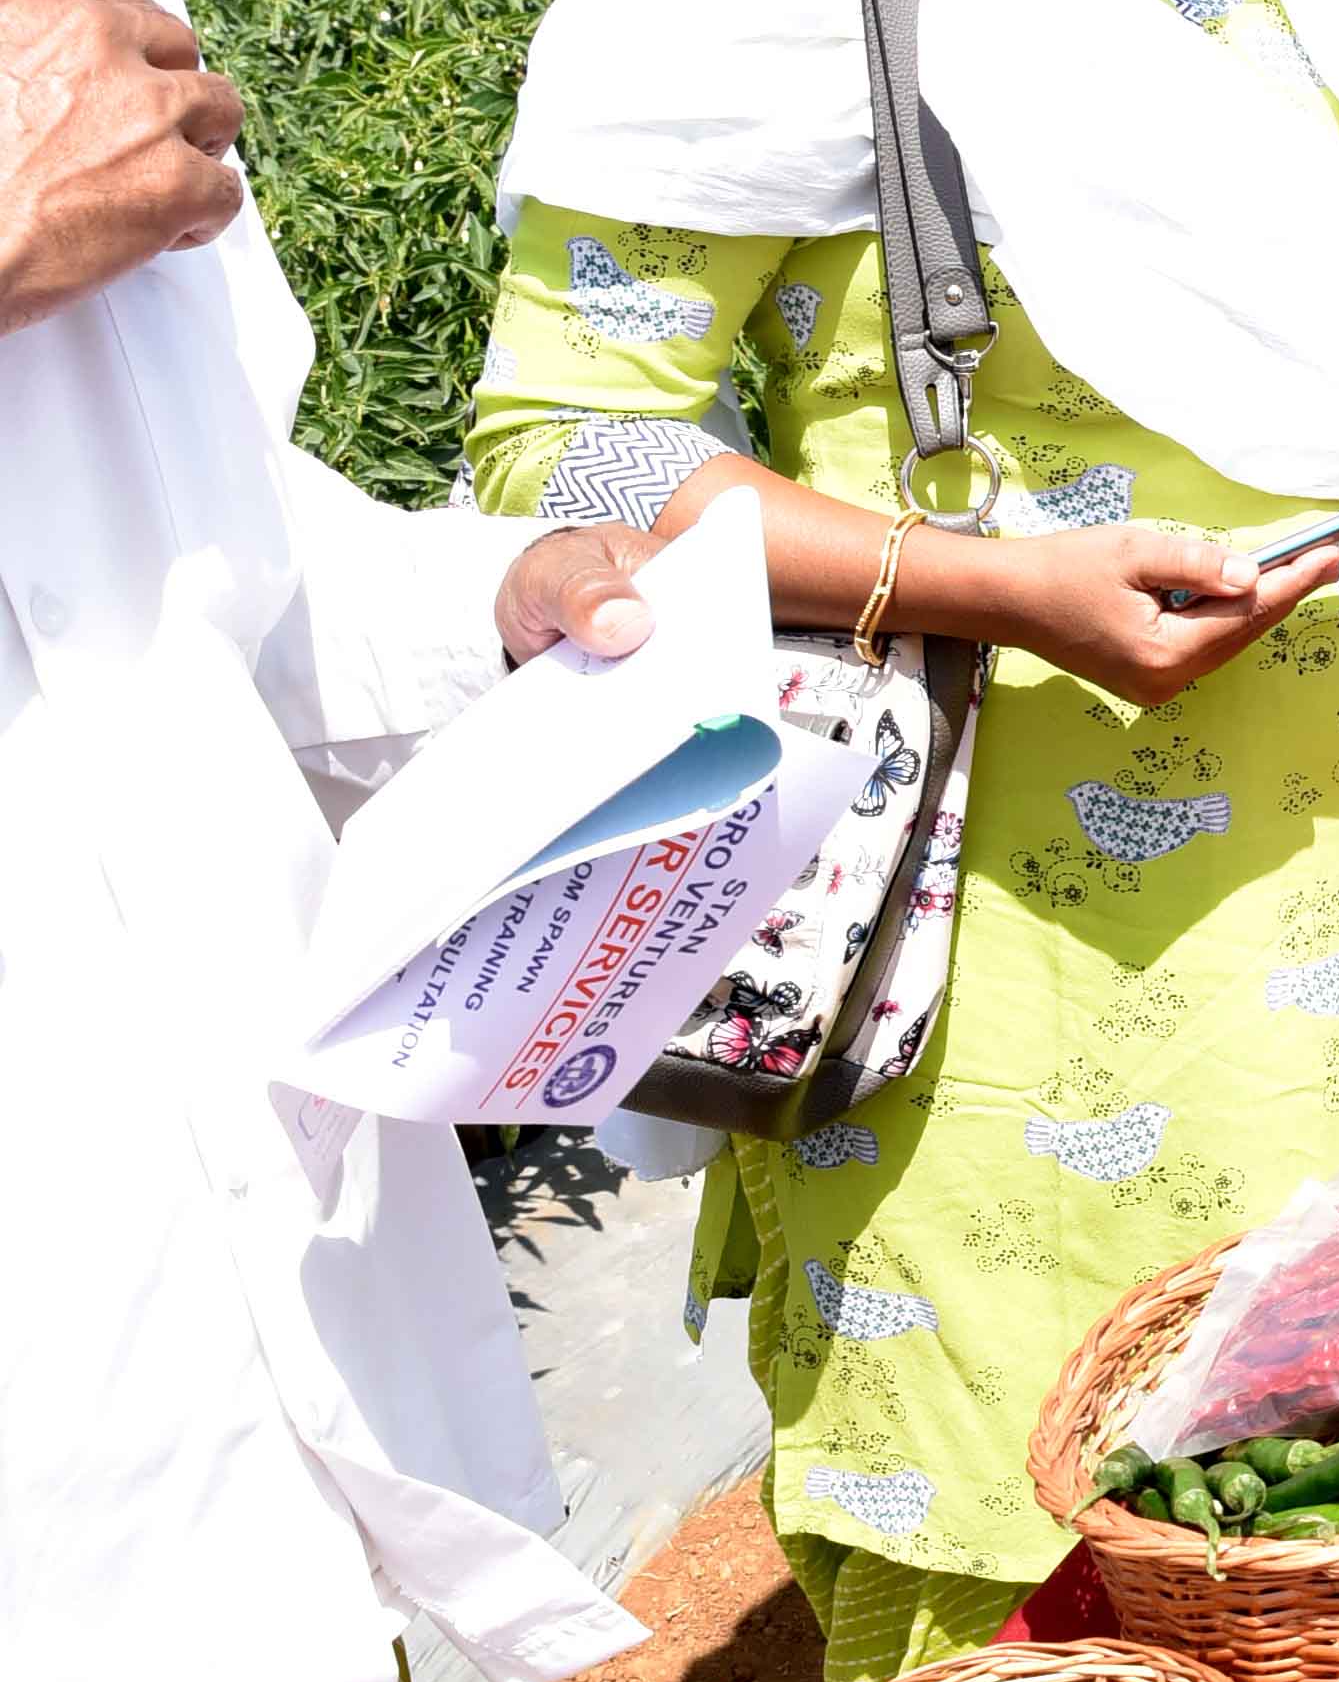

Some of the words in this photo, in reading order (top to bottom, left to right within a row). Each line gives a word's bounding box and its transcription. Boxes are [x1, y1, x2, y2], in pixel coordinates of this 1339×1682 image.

[704, 783, 774, 869] GRO
[563, 861, 593, 902] OM
[677, 878, 749, 955] STAN
[464, 892, 535, 1012] TRAINING
[505, 883, 663, 1090] SERVICES
[516, 906, 571, 994] SPAWN
[583, 880, 715, 1038] VENTURES
